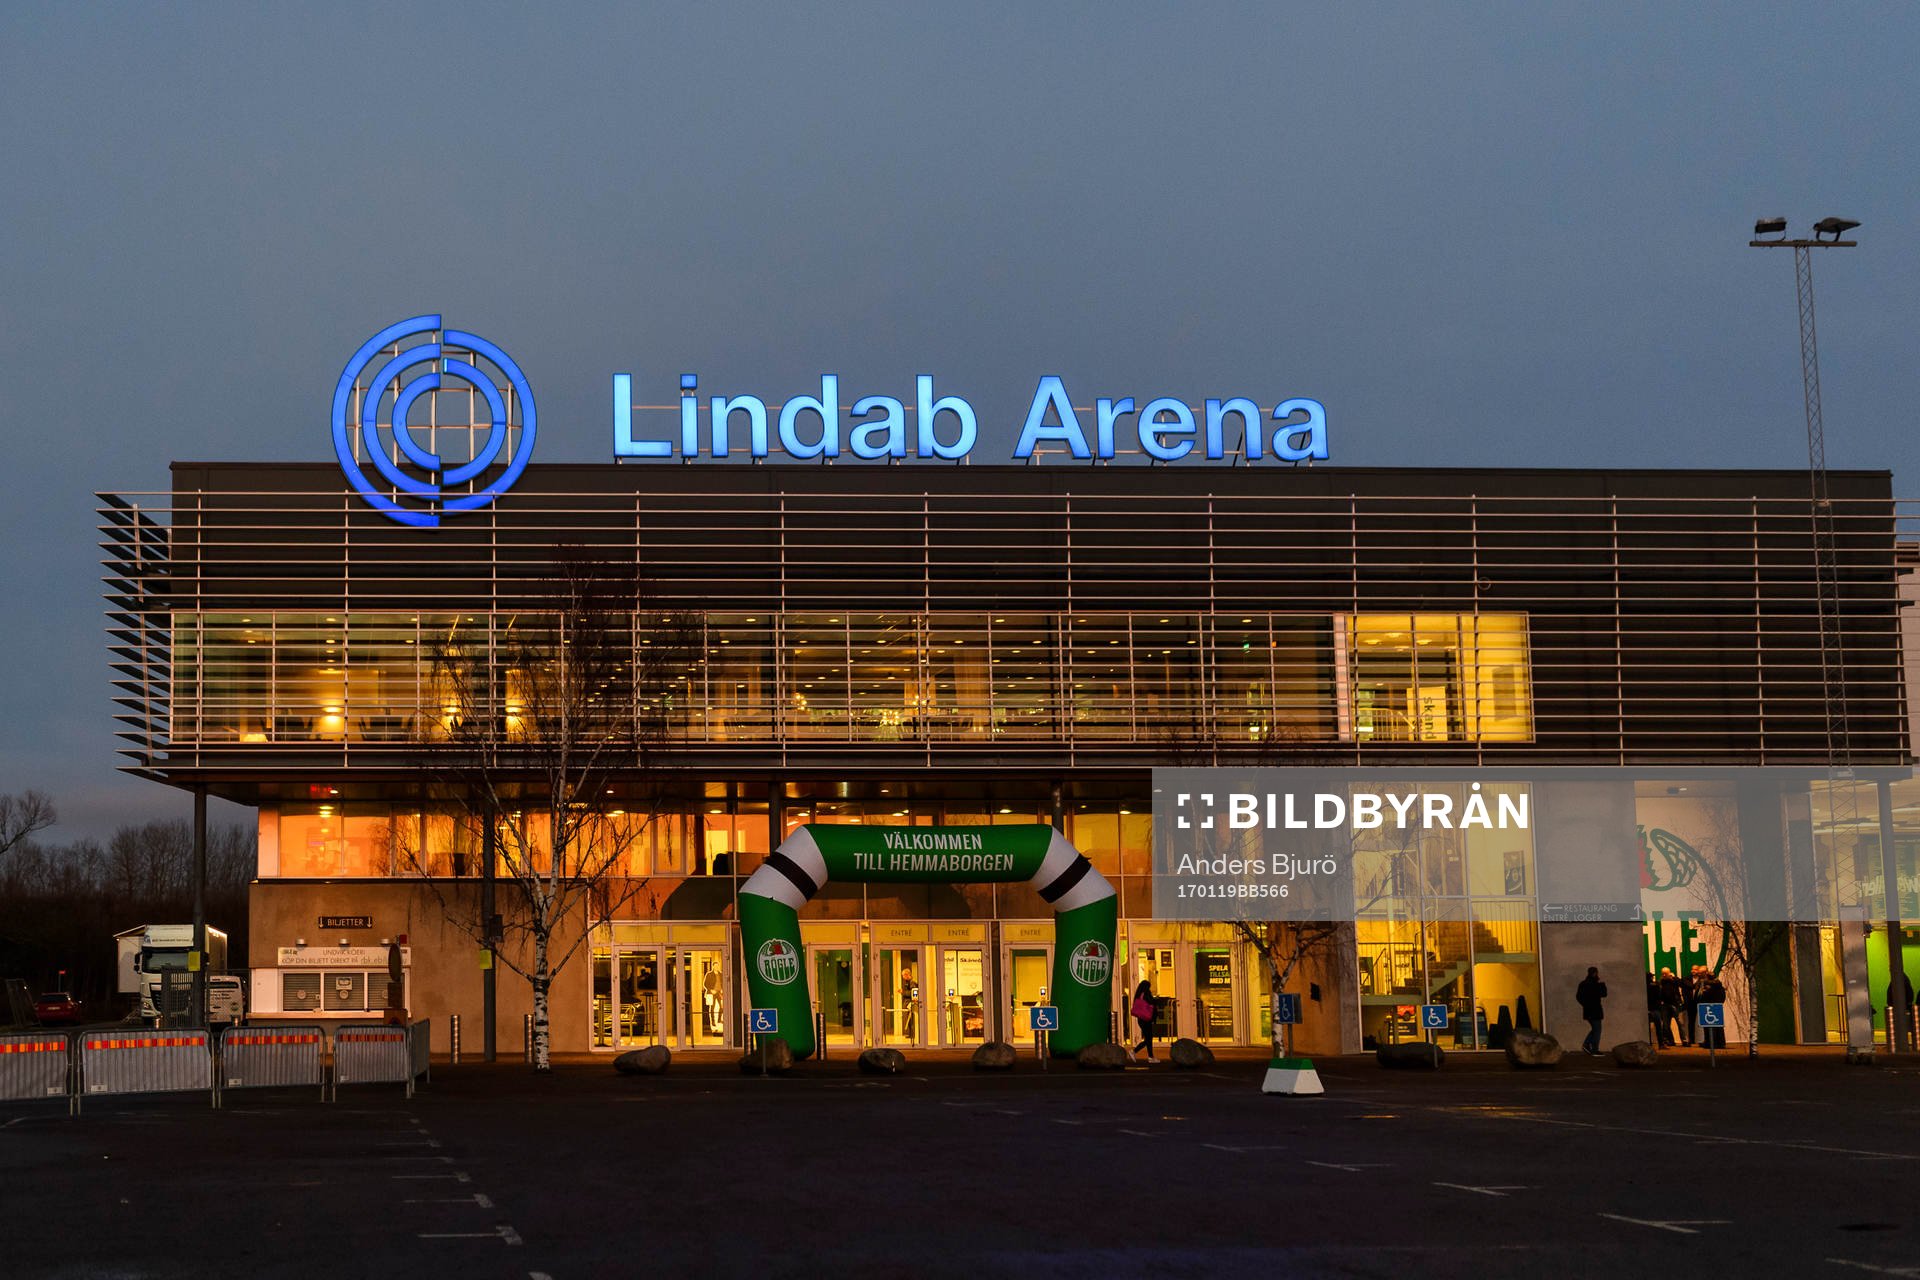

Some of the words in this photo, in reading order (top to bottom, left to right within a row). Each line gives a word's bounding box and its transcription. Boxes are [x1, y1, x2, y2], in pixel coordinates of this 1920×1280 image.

[613, 373, 978, 460] Lindab
[1012, 375, 1330, 461] Arena
[883, 831, 983, 850] VÄLKOMMEN
[853, 852, 885, 871] TILL
[890, 853, 1014, 872] HEMMABORGEN
[1563, 904, 1618, 913] RESTAURANG
[1573, 913, 1602, 922] LOGER
[327, 918, 364, 927] BILJETTER
[890, 929, 913, 937] ENTRÉ
[948, 929, 970, 937] ENTRÉ
[1020, 929, 1041, 937] ENTRÉ
[296, 957, 307, 965] DIN
[308, 957, 328, 965] BILJETT
[330, 957, 349, 965] DIREKT
[764, 956, 796, 980] RÖGLE
[1078, 958, 1107, 981] RÖGLE
